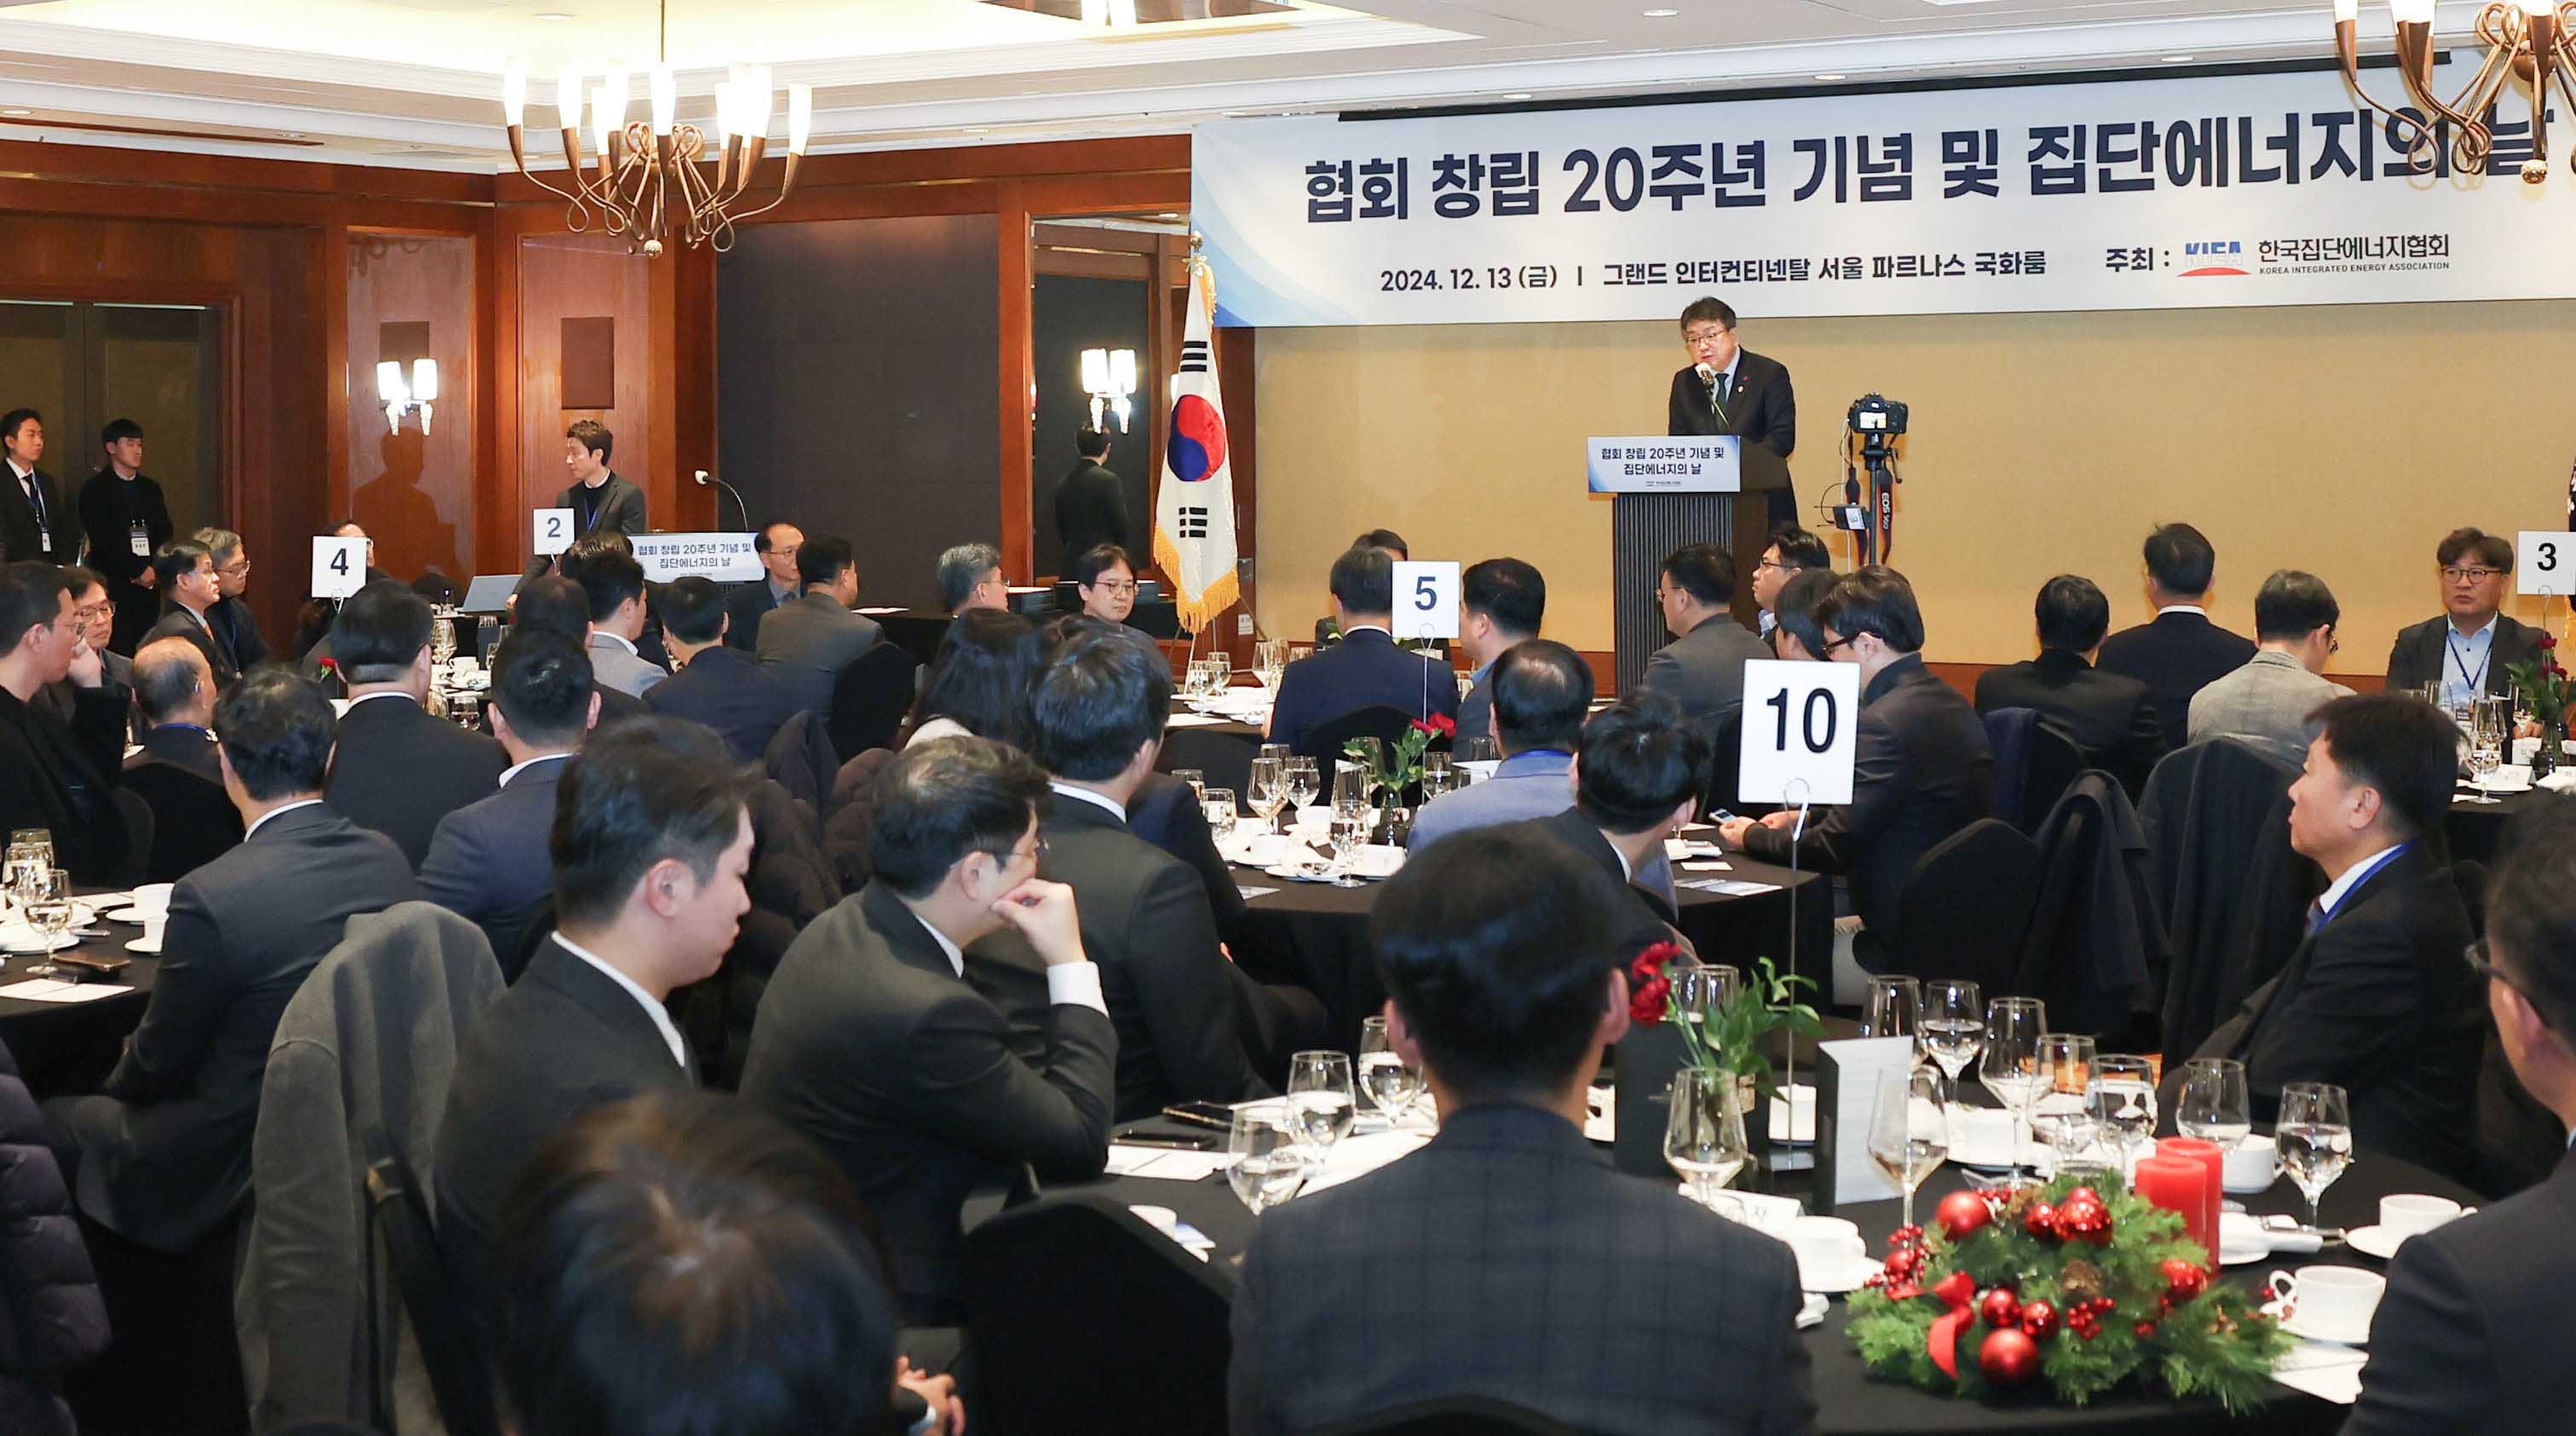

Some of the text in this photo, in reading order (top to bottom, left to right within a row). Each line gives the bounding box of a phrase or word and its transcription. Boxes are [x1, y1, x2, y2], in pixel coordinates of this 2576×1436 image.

[1305, 157, 1409, 223] 협회
[1432, 151, 1539, 219] 창립
[1563, 140, 1766, 213] 20주년
[1793, 132, 1913, 204] 기념
[1941, 129, 2000, 199] 및
[2027, 106, 2450, 197] 집단에너지의
[2106, 246, 2154, 273] 주최
[2258, 234, 2449, 262] 한국집단에너지협회
[1380, 269, 1444, 291] 2024.
[1449, 268, 1480, 290] 12.
[1603, 263, 1668, 286] 그랜드
[1675, 258, 1811, 285] 인터컨티넨탈
[1818, 256, 1864, 280] 서울
[1872, 253, 1966, 279] 파르나스
[1974, 251, 2047, 277] 국화룸
[2259, 262, 2450, 274] KOREA INTEGRATED ENERGY ASSOCIATION
[1602, 447, 1725, 460] 협회 창립 20주년 기념 및
[1624, 463, 1702, 476] 집단에너지의 날
[547, 517, 561, 538] 2
[330, 548, 349, 576] 4
[638, 545, 658, 556] 협회
[683, 544, 716, 555] 20주년
[719, 543, 739, 554] 기념
[660, 557, 717, 568] 집단에너지의
[2537, 542, 2557, 572] 3
[1415, 576, 1438, 611] 5
[1766, 687, 1837, 754] 10
